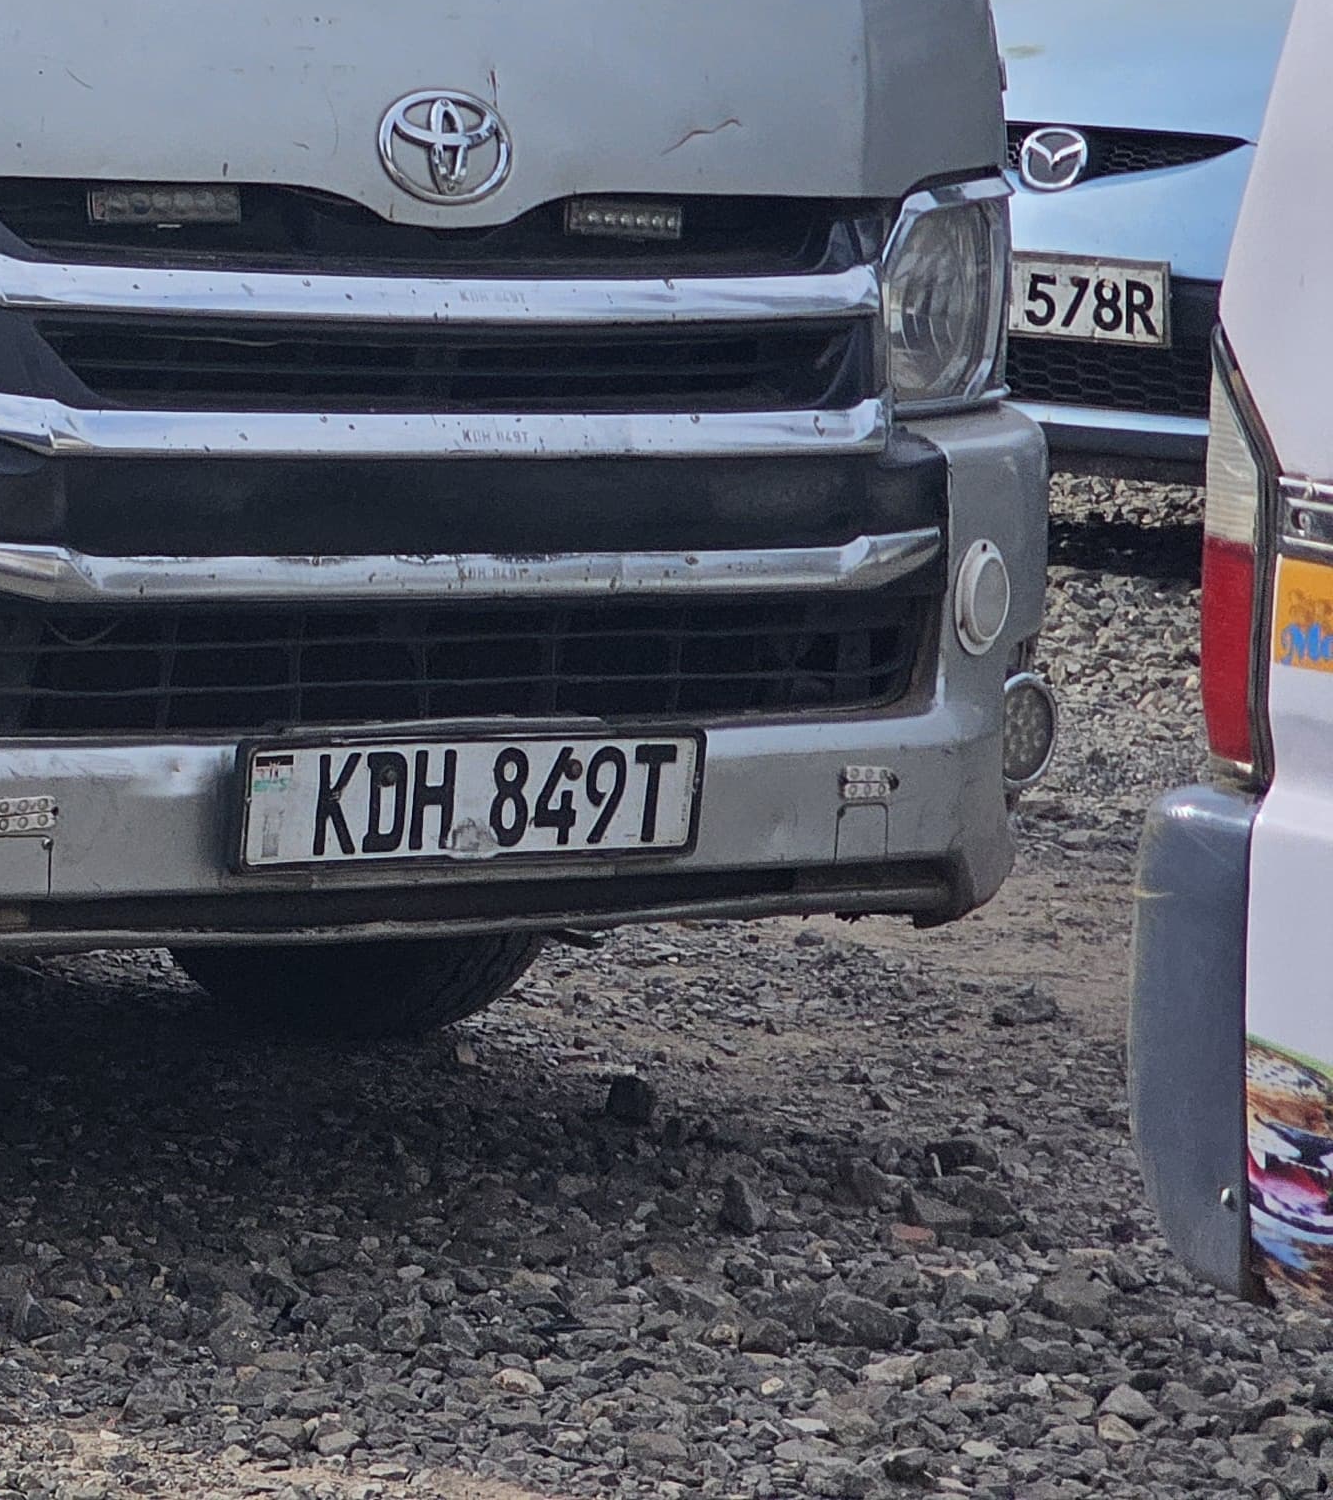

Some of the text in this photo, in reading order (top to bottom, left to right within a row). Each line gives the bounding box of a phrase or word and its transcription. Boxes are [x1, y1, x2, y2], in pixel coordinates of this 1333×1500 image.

[1024, 273, 1158, 337] 578R
[312, 748, 457, 855] KDH
[489, 744, 679, 847] 849T
